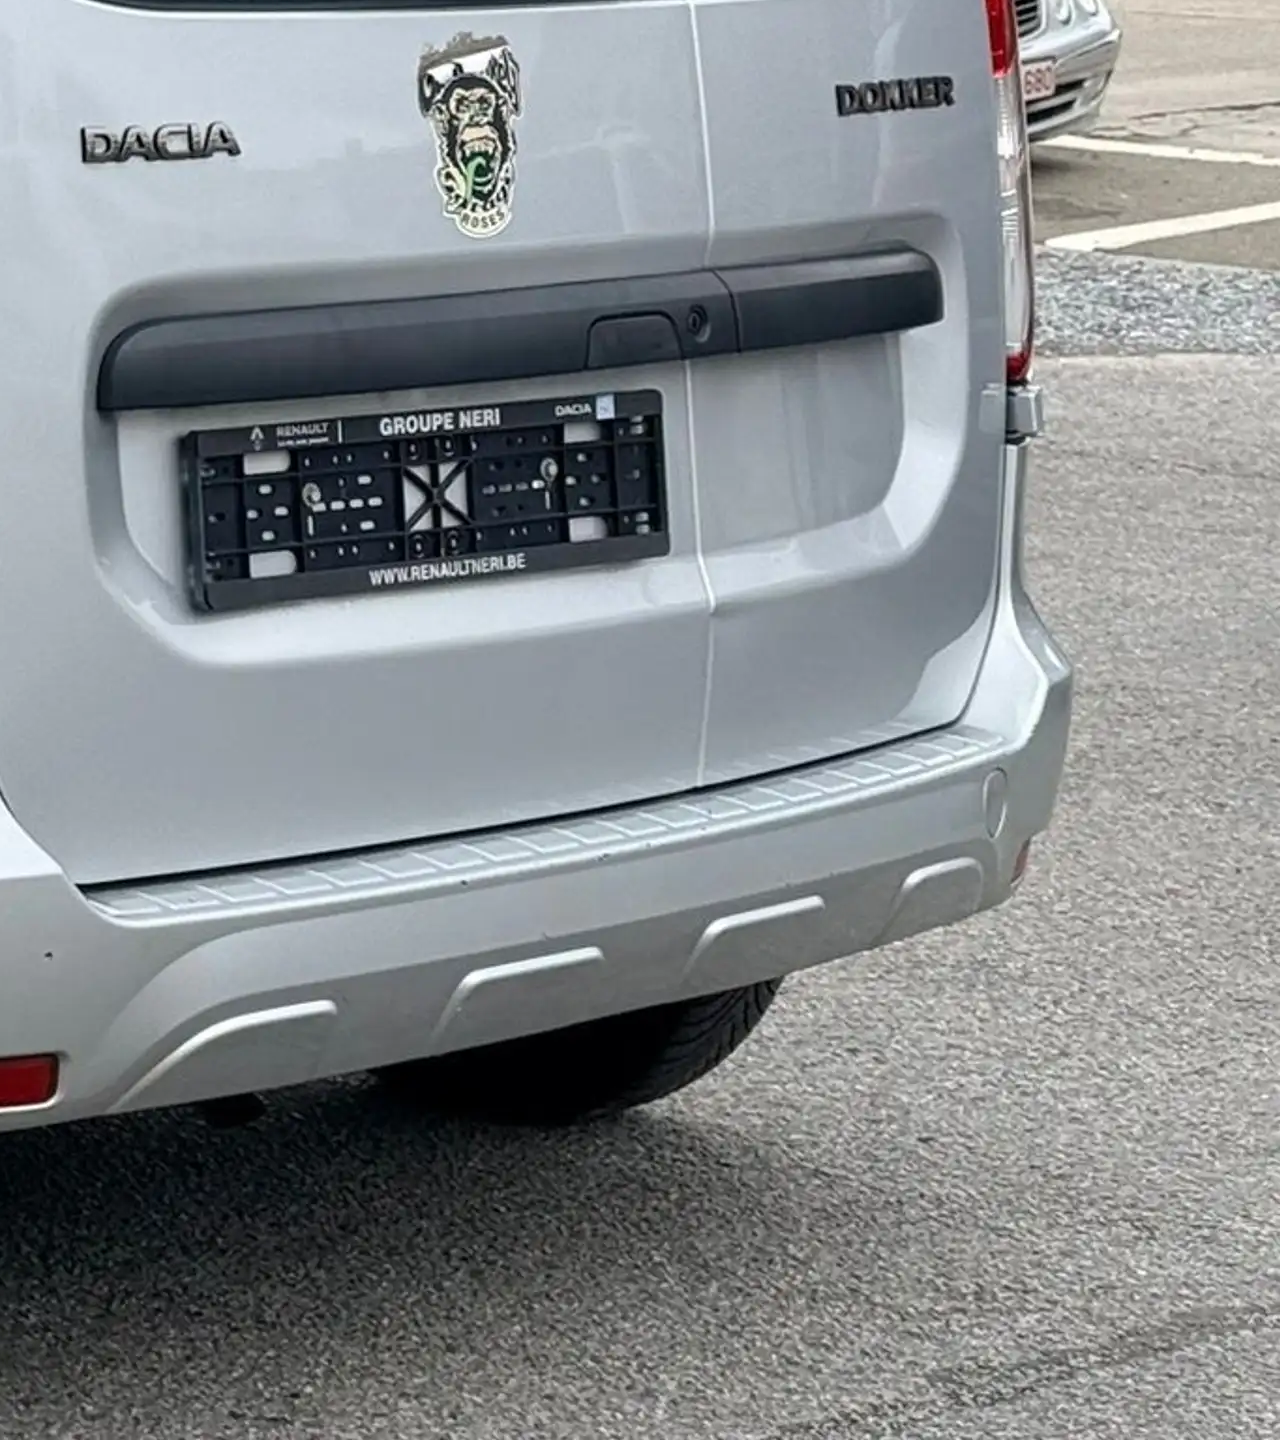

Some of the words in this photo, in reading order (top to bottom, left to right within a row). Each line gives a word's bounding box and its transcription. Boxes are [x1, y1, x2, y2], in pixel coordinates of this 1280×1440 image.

[836, 76, 955, 117] DOKKER
[80, 120, 242, 164] DACIA
[379, 411, 455, 437] GROUPE
[458, 407, 501, 429] NERI
[555, 403, 592, 417] DACIA
[276, 421, 329, 437] RENAULT
[368, 552, 527, 587] WWW.RENAULTNERI.BE
